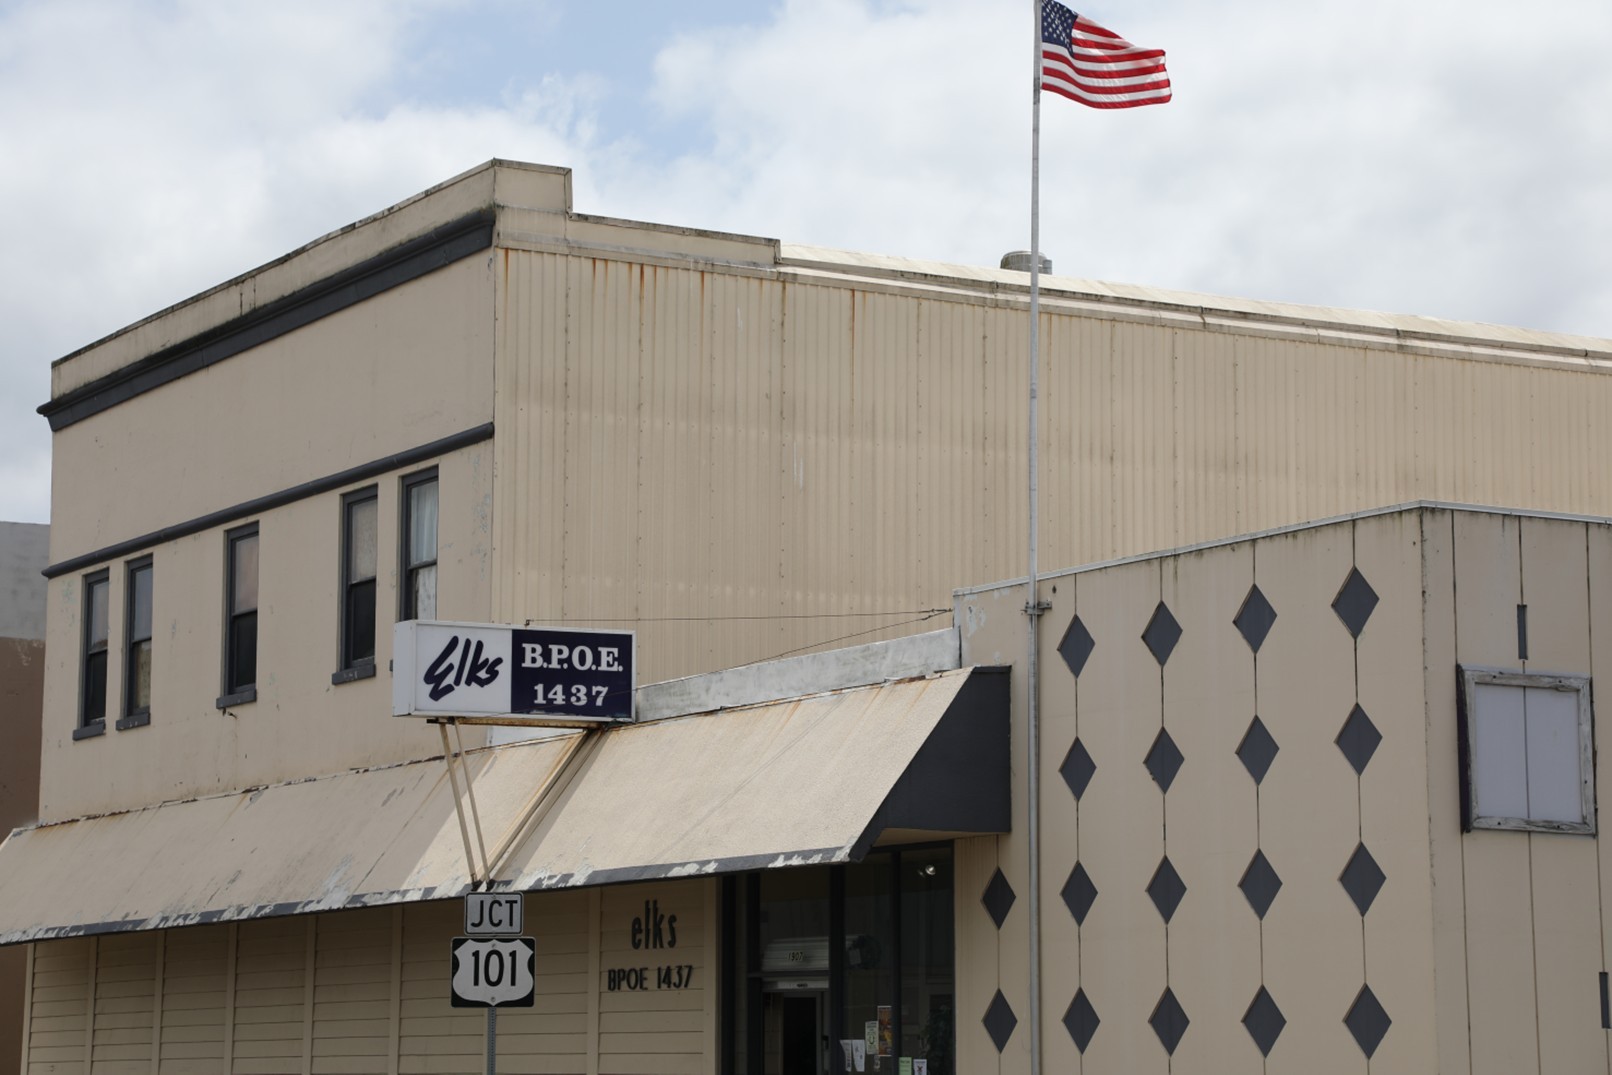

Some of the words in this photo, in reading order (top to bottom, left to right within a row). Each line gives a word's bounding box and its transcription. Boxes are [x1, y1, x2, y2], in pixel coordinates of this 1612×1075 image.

[423, 635, 504, 702] Elks
[521, 643, 624, 672] B.P.O.E.
[533, 683, 609, 707] 1437
[470, 899, 518, 928] JCT
[631, 899, 678, 950] elks
[471, 949, 517, 987] 101
[607, 967, 649, 992] BPOE
[657, 965, 693, 989] 1437
